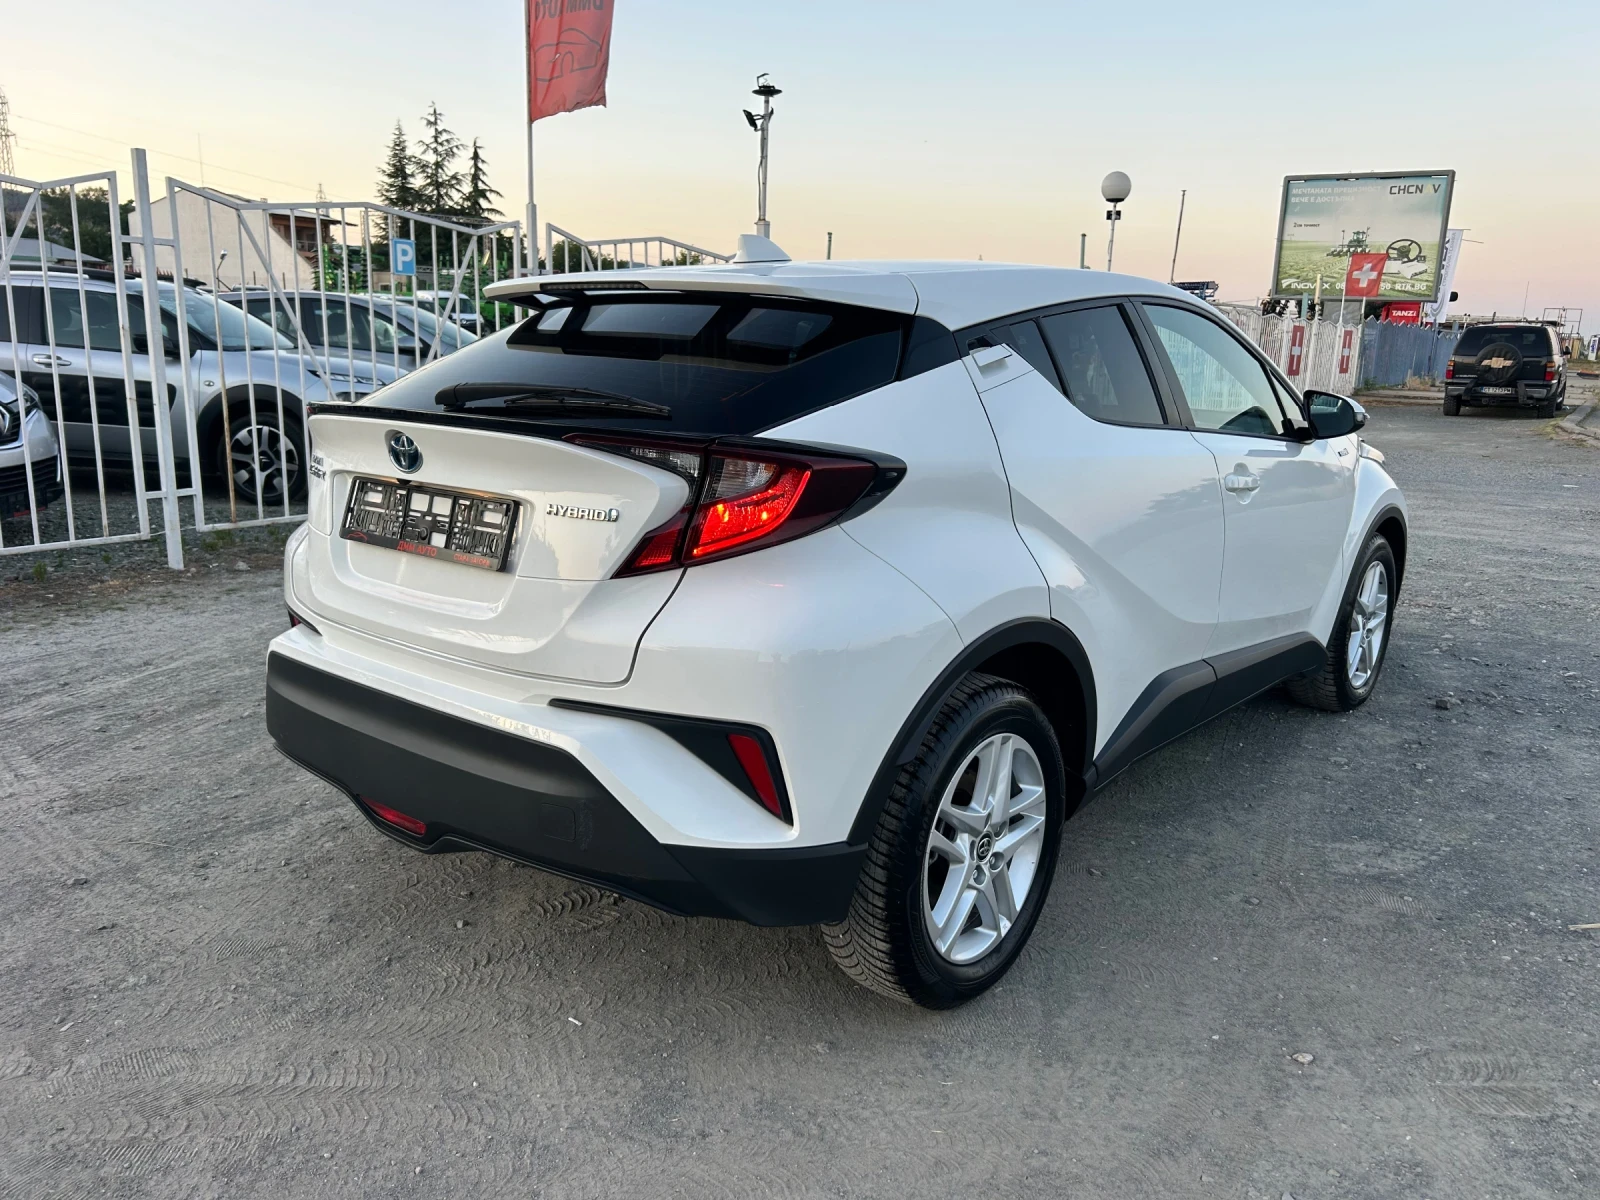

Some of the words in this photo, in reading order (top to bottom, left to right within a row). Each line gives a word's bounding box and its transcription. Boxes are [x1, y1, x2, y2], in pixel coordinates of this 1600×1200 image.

[1291, 187, 1332, 195] МЕЧТАНАТА
[396, 244, 413, 271] P
[546, 503, 607, 521] HYBRID
[397, 541, 415, 552] ДММ
[416, 545, 437, 557] АУТО
